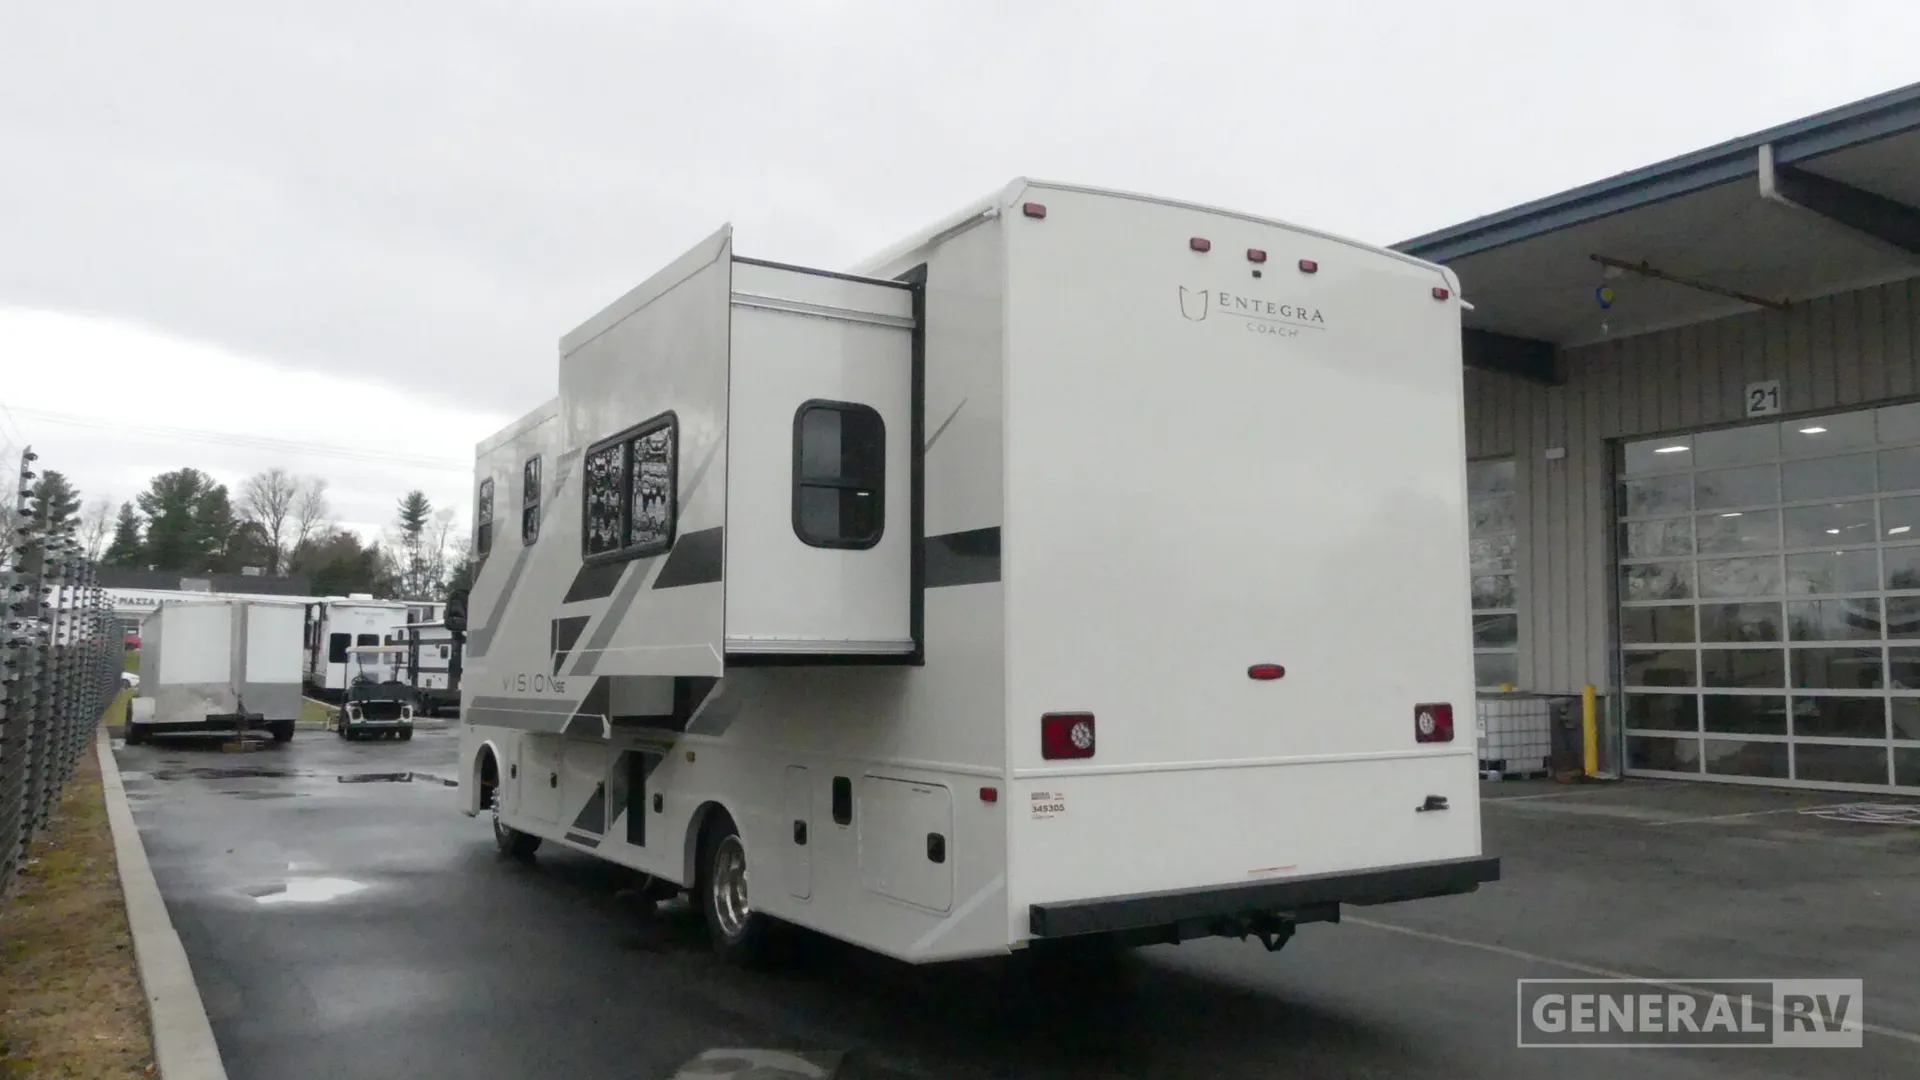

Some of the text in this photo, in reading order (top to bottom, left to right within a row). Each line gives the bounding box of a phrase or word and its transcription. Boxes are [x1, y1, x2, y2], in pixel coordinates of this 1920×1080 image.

[1219, 292, 1325, 323] ENTEGRA
[1246, 322, 1299, 338] COACH
[1750, 386, 1778, 411] 21
[119, 597, 155, 606] PIAZZA
[502, 673, 557, 693] VISION
